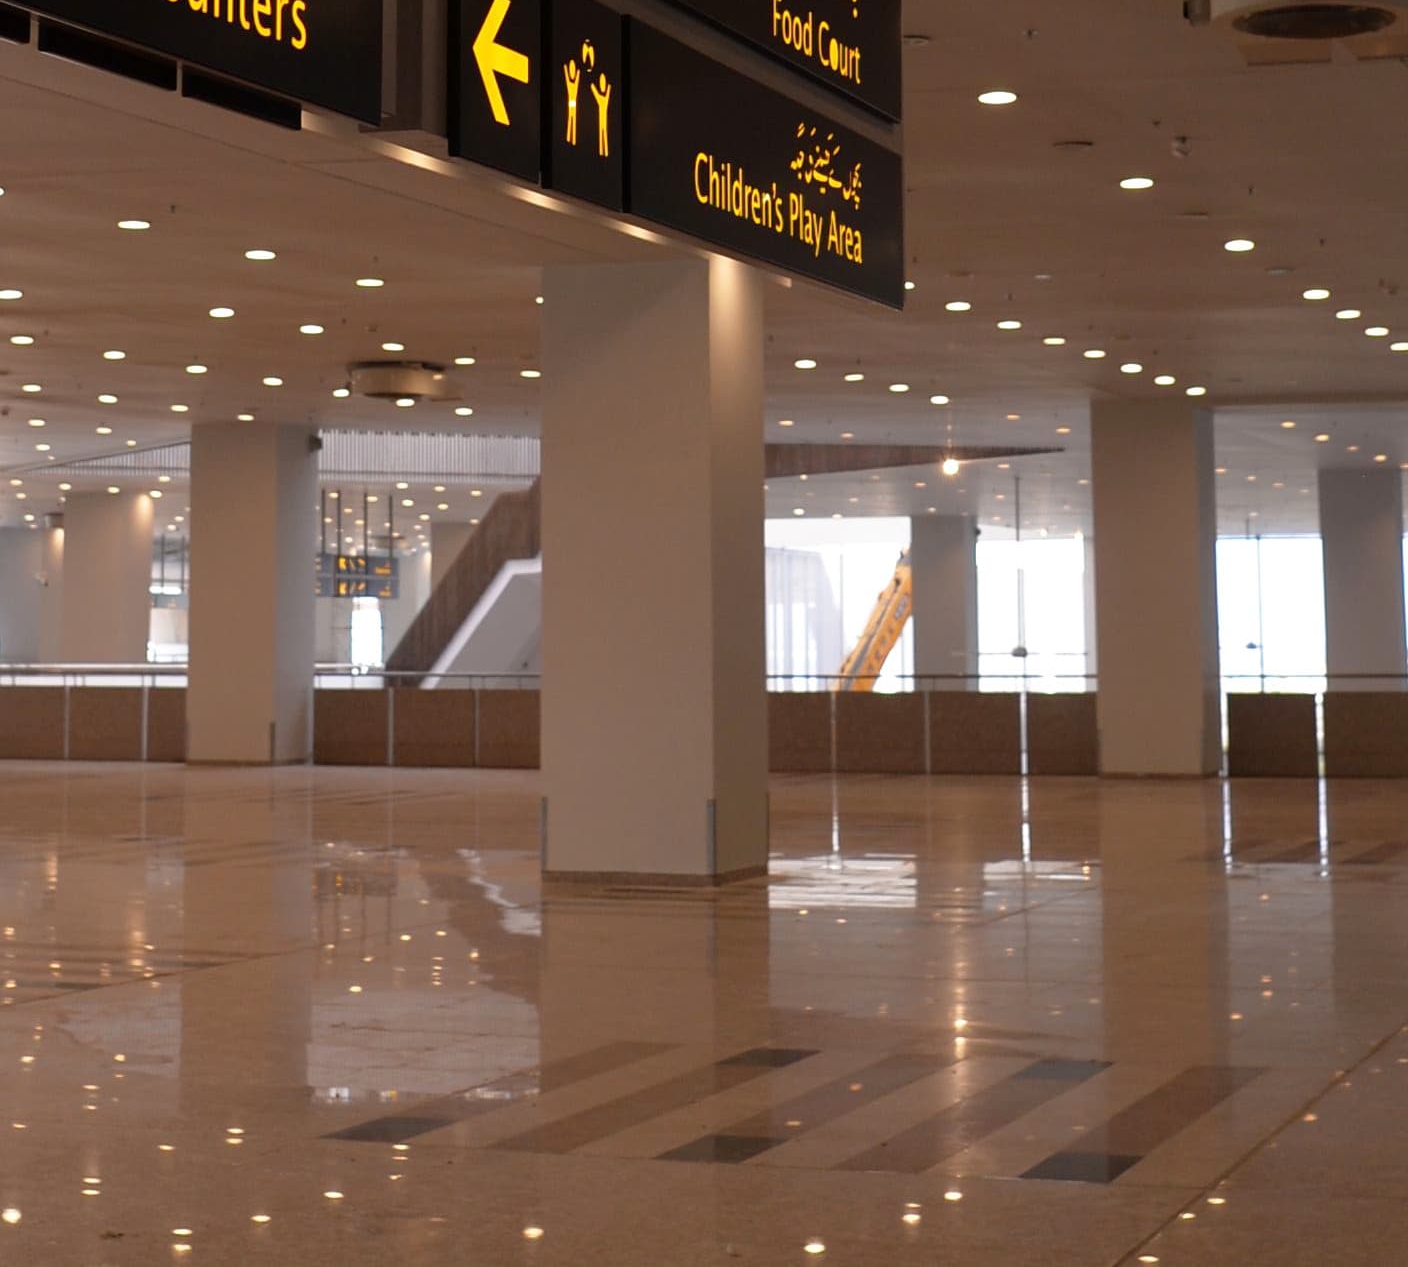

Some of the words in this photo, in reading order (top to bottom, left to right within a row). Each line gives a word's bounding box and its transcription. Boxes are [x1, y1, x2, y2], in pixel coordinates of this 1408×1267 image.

[817, 20, 861, 84] Court
[788, 191, 823, 258] Play
[827, 210, 863, 265] Area
